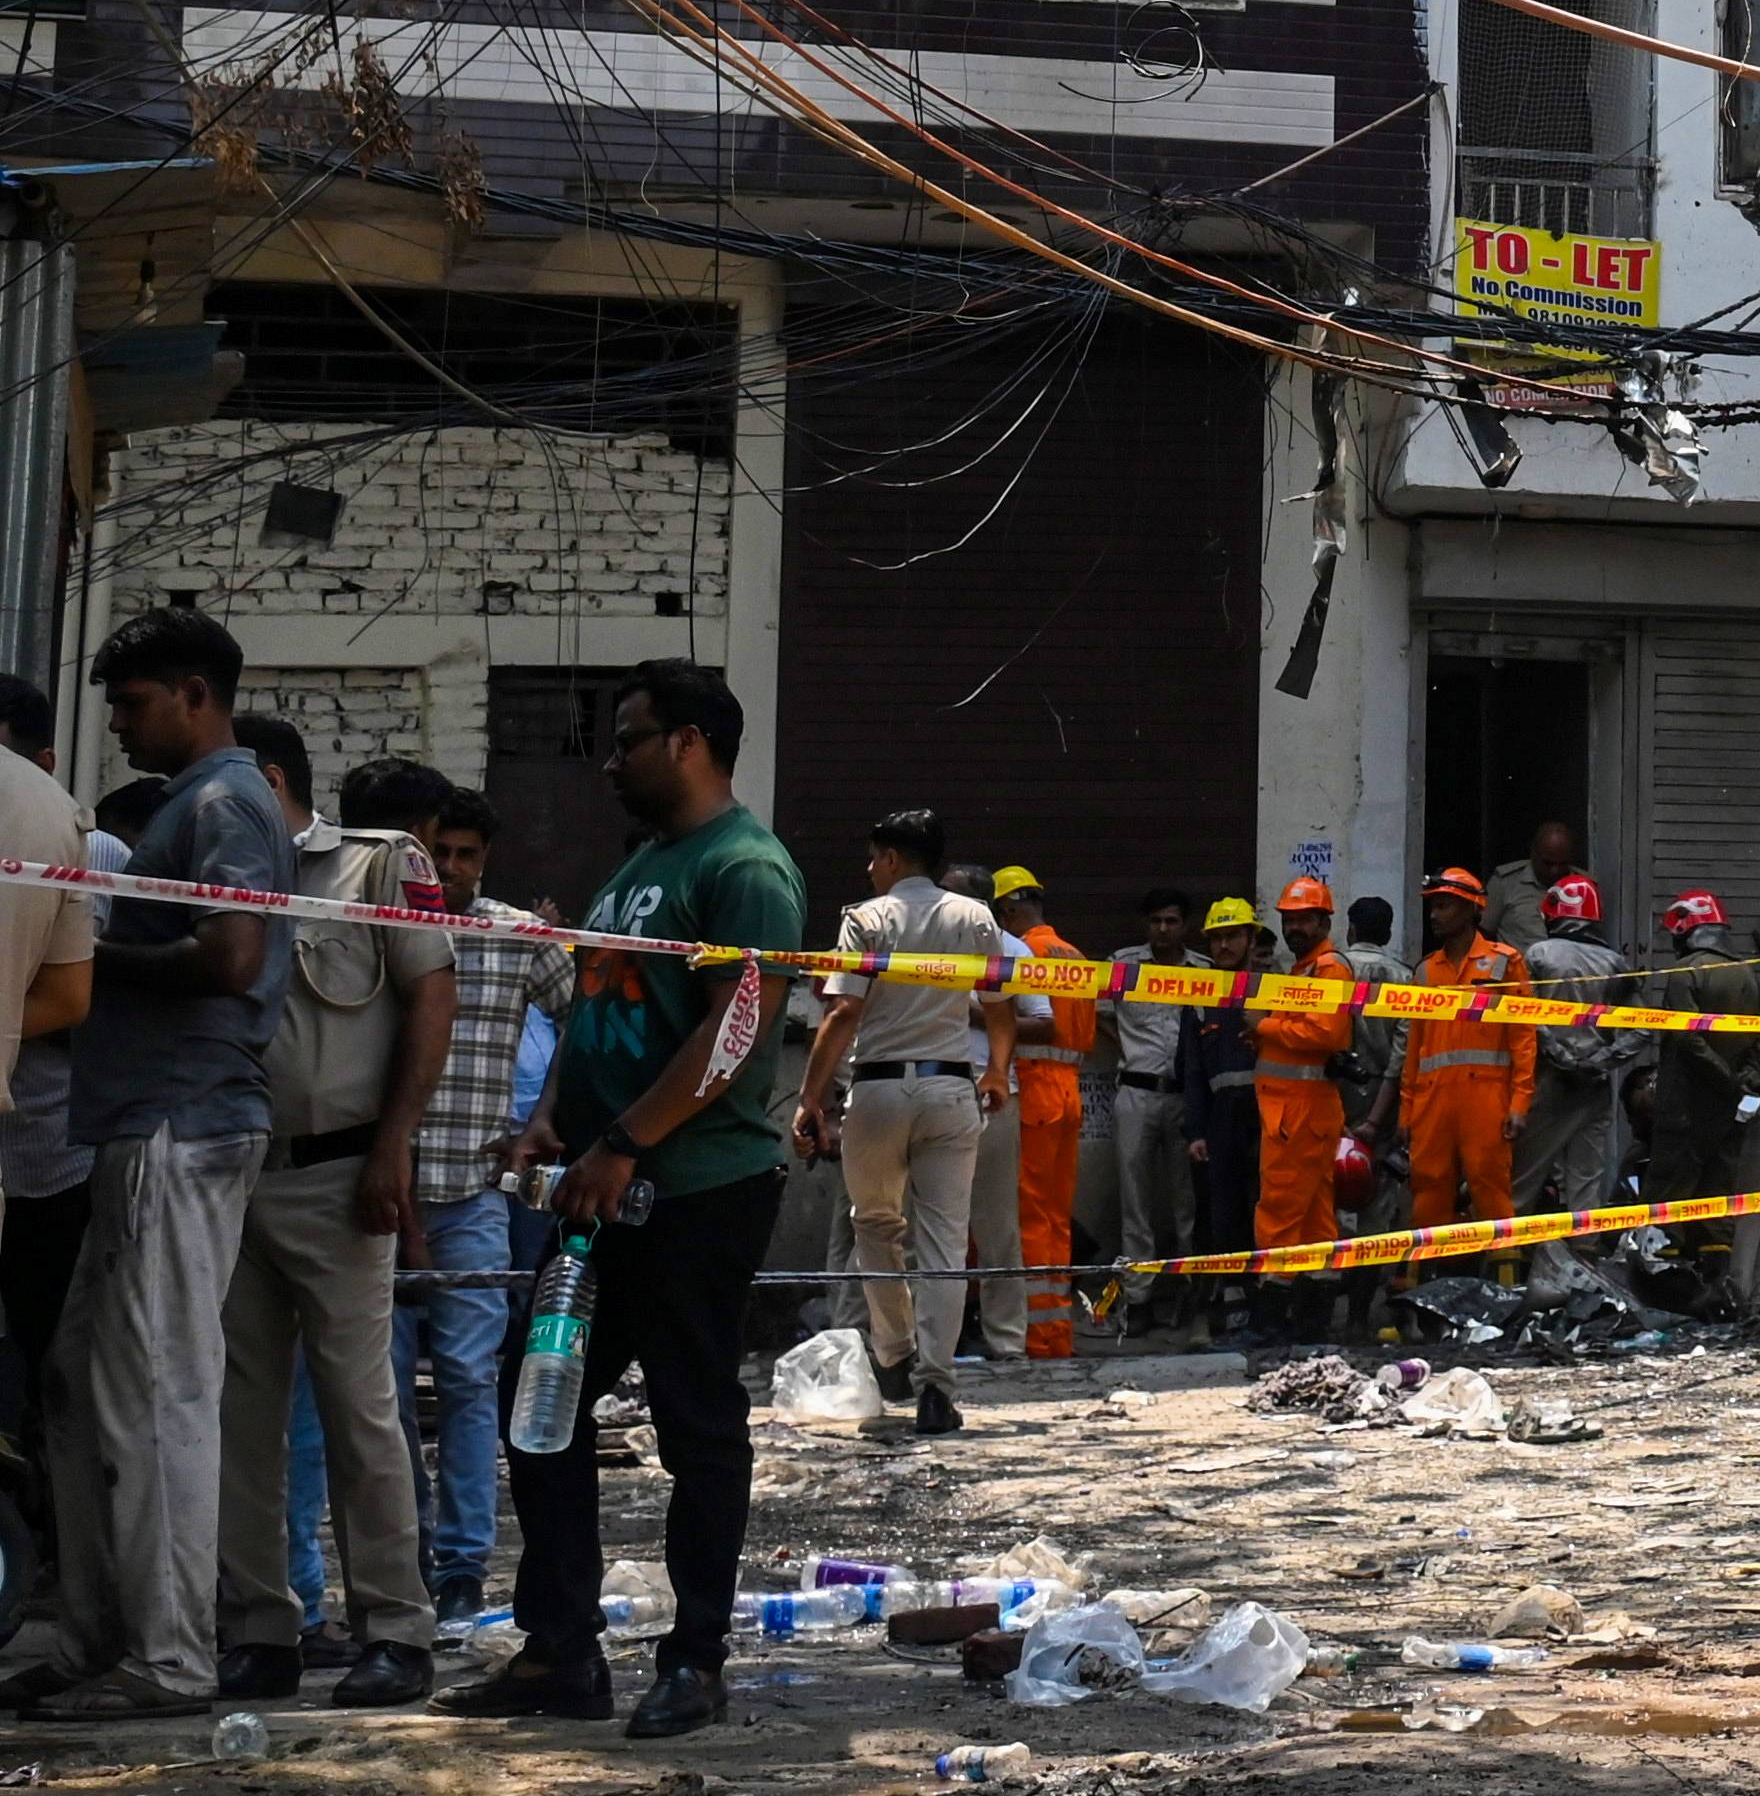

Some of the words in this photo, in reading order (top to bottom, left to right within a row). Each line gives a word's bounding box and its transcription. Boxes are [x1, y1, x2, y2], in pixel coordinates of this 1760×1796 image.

[1465, 226, 1529, 276] TO
[1571, 241, 1652, 293] LET
[1471, 275, 1499, 296] No
[1505, 281, 1643, 318] Commission
[233, 887, 290, 908] MEN
[375, 906, 495, 930] CAUTION
[1019, 962, 1047, 982] DO
[1054, 964, 1097, 984] NOT
[1147, 977, 1215, 997] DELHI
[1385, 990, 1412, 1006] DO
[1417, 991, 1459, 1008] NOT
[1681, 1202, 1712, 1218] LINE
[1592, 1213, 1647, 1231] POLICE
[1448, 1225, 1479, 1240] LINE
[1355, 1234, 1411, 1253] POLICE
[1190, 1259, 1220, 1272] NOT
[1223, 1259, 1244, 1271] DO
